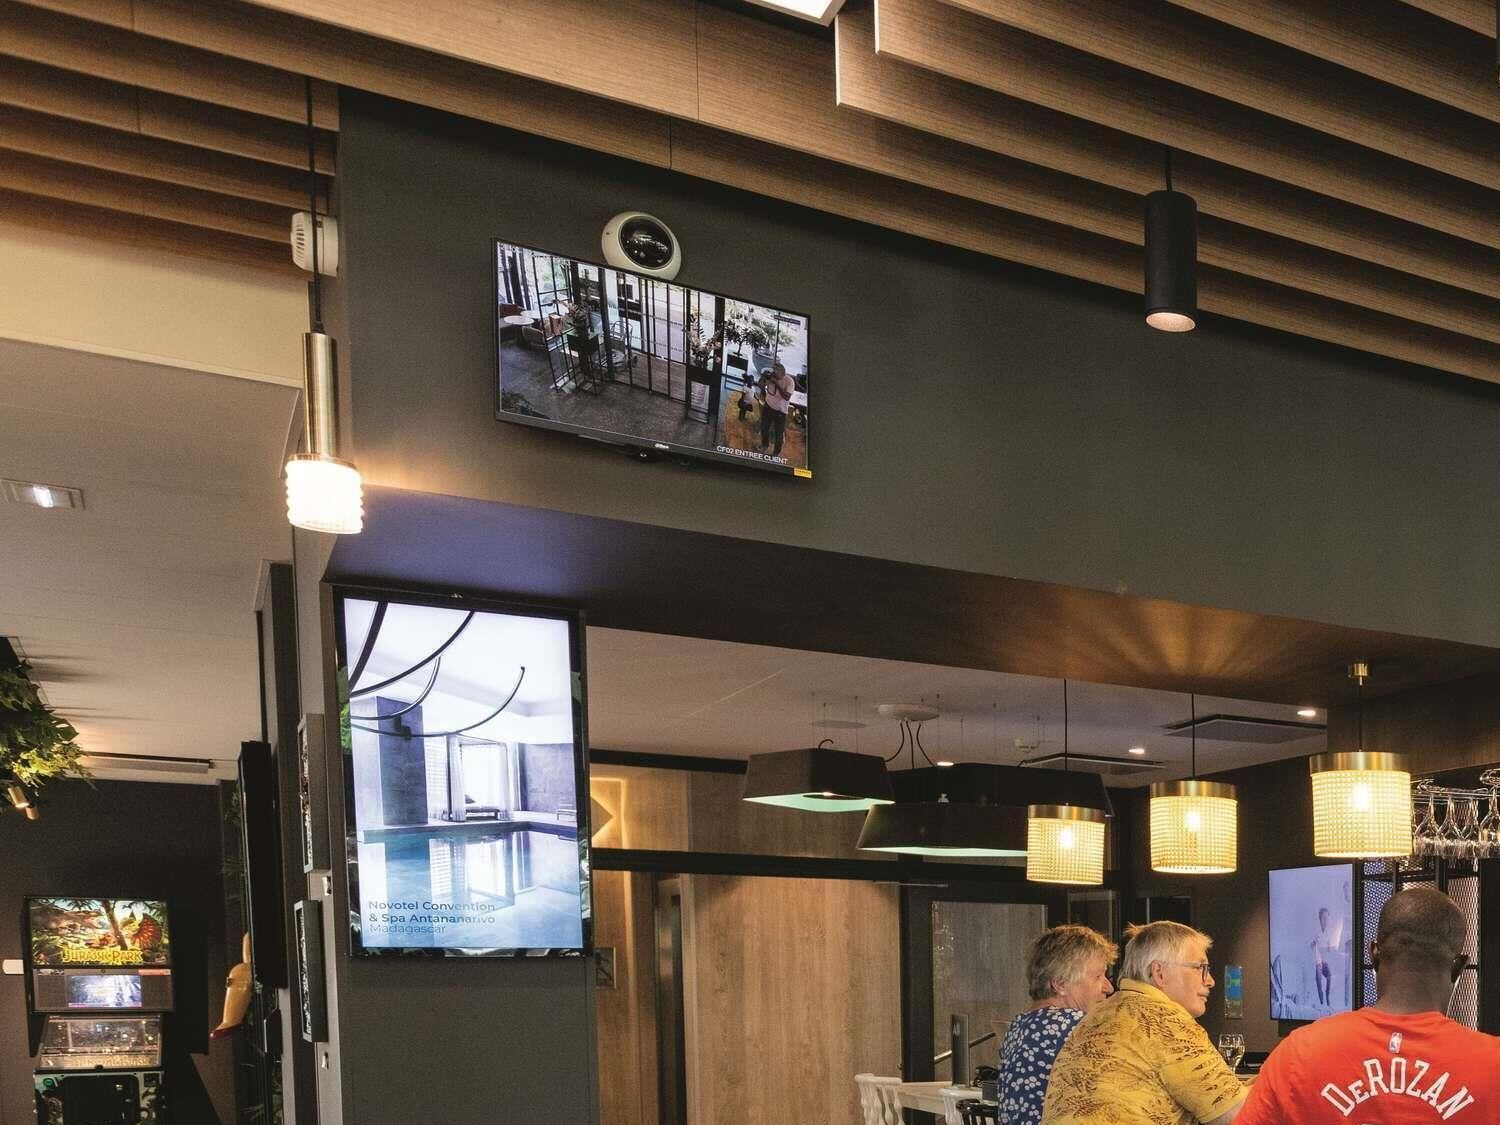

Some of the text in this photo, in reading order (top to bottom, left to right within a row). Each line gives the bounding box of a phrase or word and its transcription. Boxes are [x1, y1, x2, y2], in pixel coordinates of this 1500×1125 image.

[716, 445, 788, 464] CF02 ENTREE CLIENT
[368, 901, 495, 911] Novotel Convention
[368, 913, 496, 924] & Spa Antananarivo
[369, 924, 446, 934] Madagascar
[62, 949, 143, 961] JURASSIC PARK
